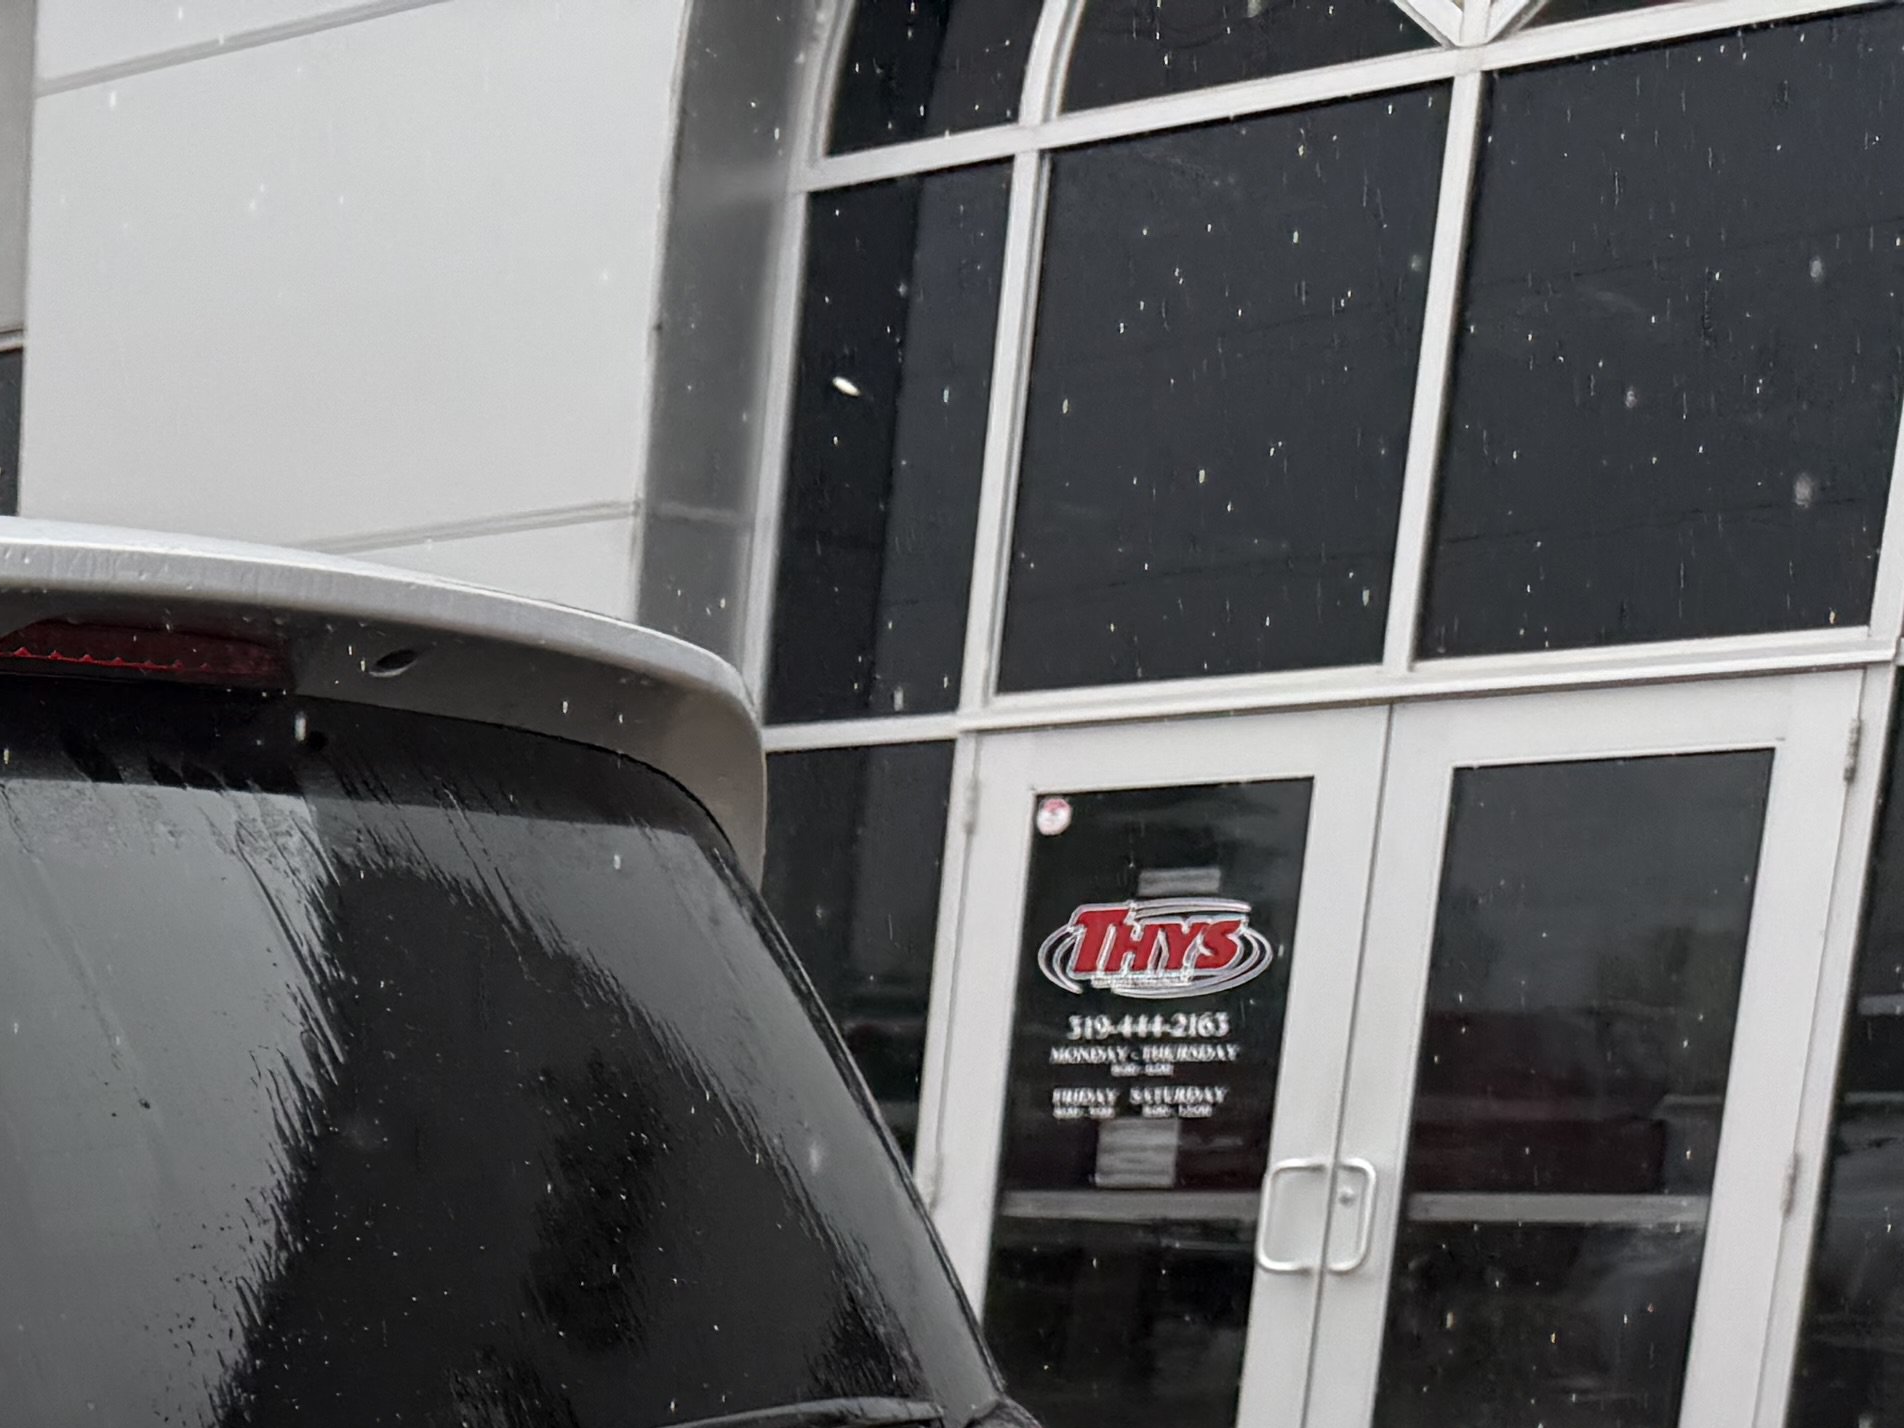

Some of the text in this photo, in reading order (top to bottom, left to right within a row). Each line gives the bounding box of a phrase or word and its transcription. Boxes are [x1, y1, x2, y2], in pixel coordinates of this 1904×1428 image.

[1069, 902, 1247, 978] THYS
[1066, 1012, 1230, 1040] 319-444-2163
[1049, 1045, 1128, 1064] MONDAY
[1142, 1043, 1240, 1062] THURSDAY
[1052, 1087, 1119, 1105] FRIDAY
[1130, 1085, 1229, 1104] SATURDAY
